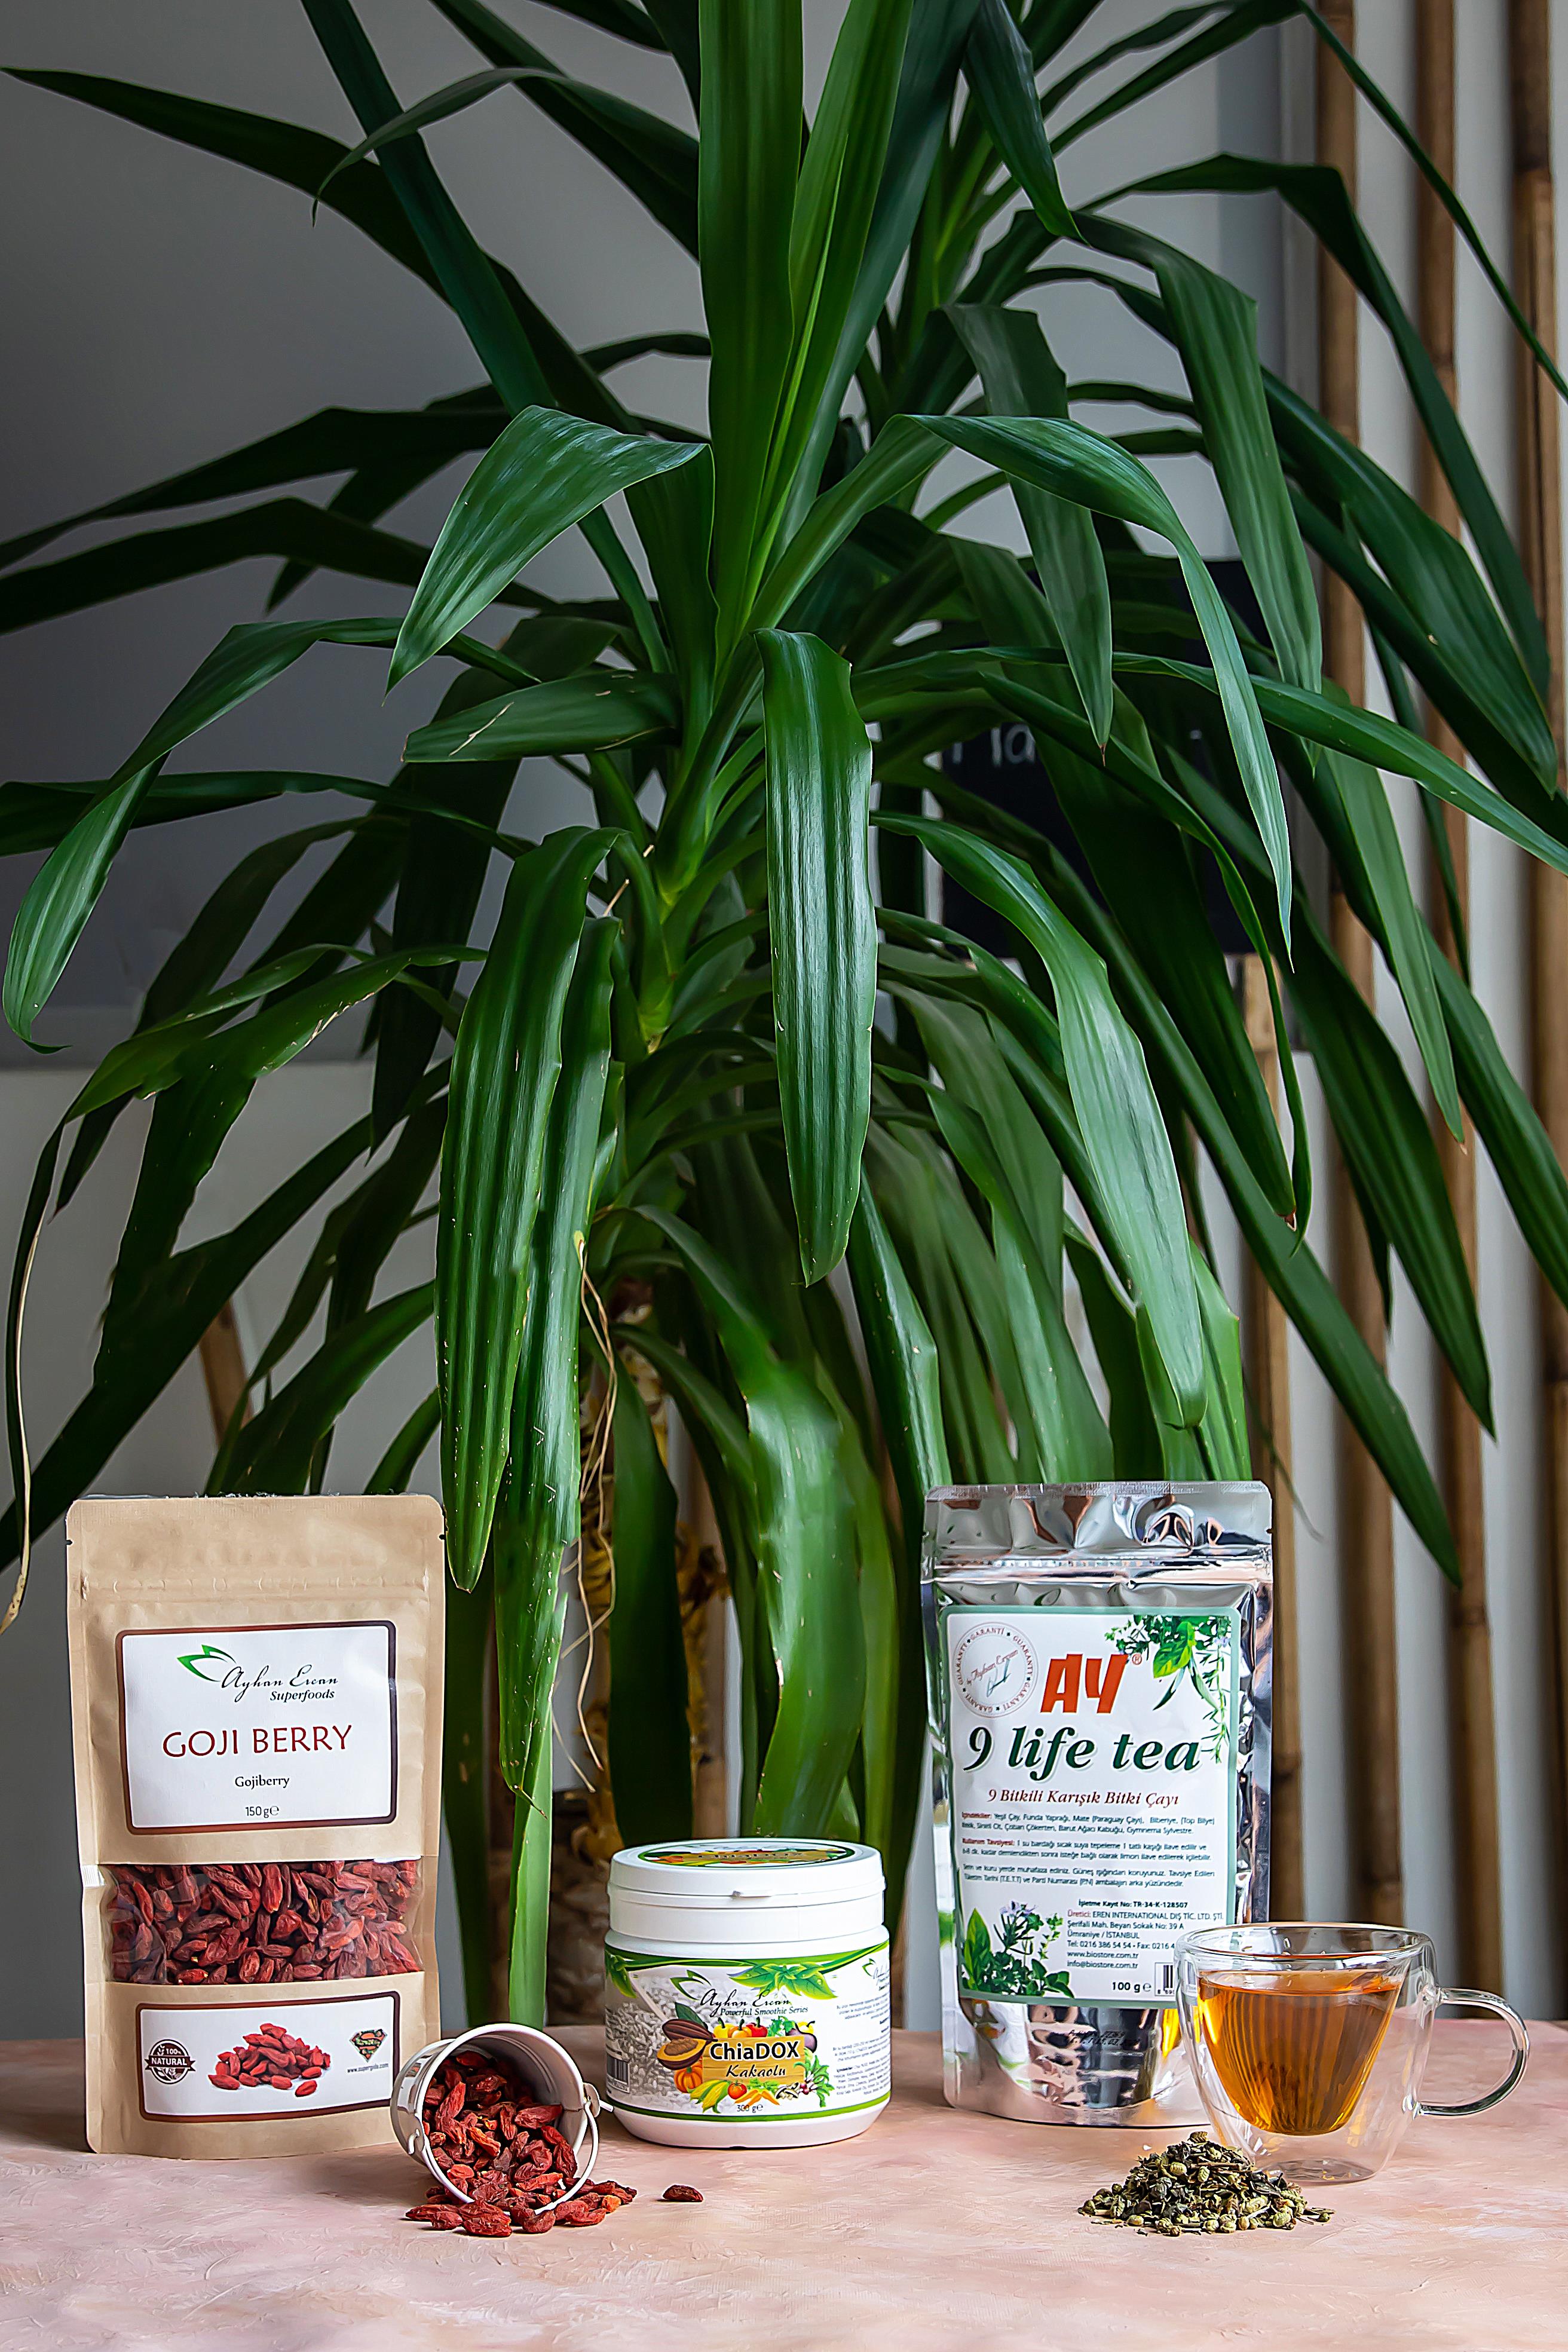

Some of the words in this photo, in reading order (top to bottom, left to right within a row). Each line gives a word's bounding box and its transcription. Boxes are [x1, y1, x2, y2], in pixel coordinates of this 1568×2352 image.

[222, 1665, 283, 1702] Ayhan
[1040, 1653, 1128, 1714] AY
[270, 1689, 335, 1702] Superfoods
[163, 1729, 238, 1757] GOJI
[253, 1725, 352, 1753] BERRY
[963, 1726, 993, 1772] 9
[1008, 1725, 1095, 1781] life
[1113, 1734, 1202, 1771] tea
[234, 1775, 290, 1790] Gojiberry
[987, 1789, 997, 1802] 9
[1000, 1789, 1043, 1802] Bitkili
[1047, 1790, 1100, 1806] Karışık
[1105, 1791, 1141, 1805] Bitki
[1146, 1792, 1179, 1808] Çayı
[1110, 1922, 1131, 1930] Beyan
[1067, 1930, 1100, 1940] Ümraniye
[1106, 1931, 1140, 1939] İSTANBUL
[1067, 1951, 1138, 1959] www.biostore.com.tr
[1067, 1960, 1138, 1969] info@biostore.com.tr
[1112, 1982, 1131, 1990] 100
[700, 1989, 748, 2017] Ayhan
[720, 2008, 752, 2018] Powerful
[755, 2007, 787, 2016] Smoothie
[709, 2041, 800, 2060] ChiaDOX
[151, 2057, 188, 2066] NATURAL
[725, 2064, 786, 2078] Kakaolu
